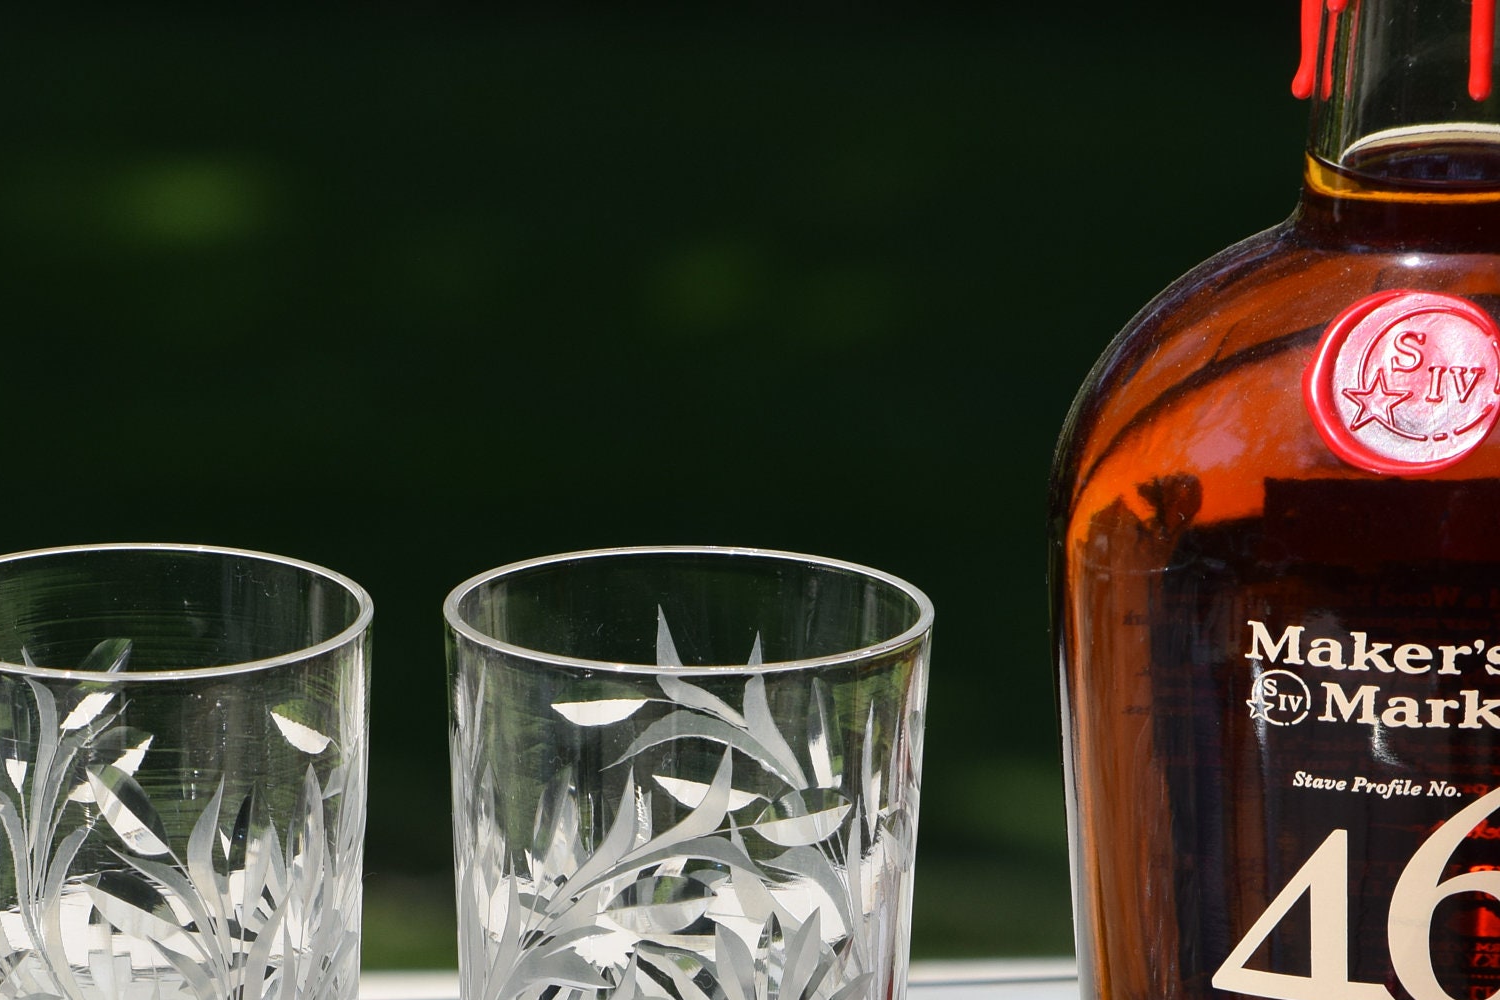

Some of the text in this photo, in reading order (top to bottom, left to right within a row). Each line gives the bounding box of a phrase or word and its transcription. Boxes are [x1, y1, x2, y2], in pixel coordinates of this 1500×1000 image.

[1390, 330, 1486, 404] S IV
[1244, 620, 1500, 676] Maker's
[1262, 678, 1304, 713] S IV
[1317, 681, 1500, 730] Mark
[1292, 770, 1463, 800] Stave Profile No.
